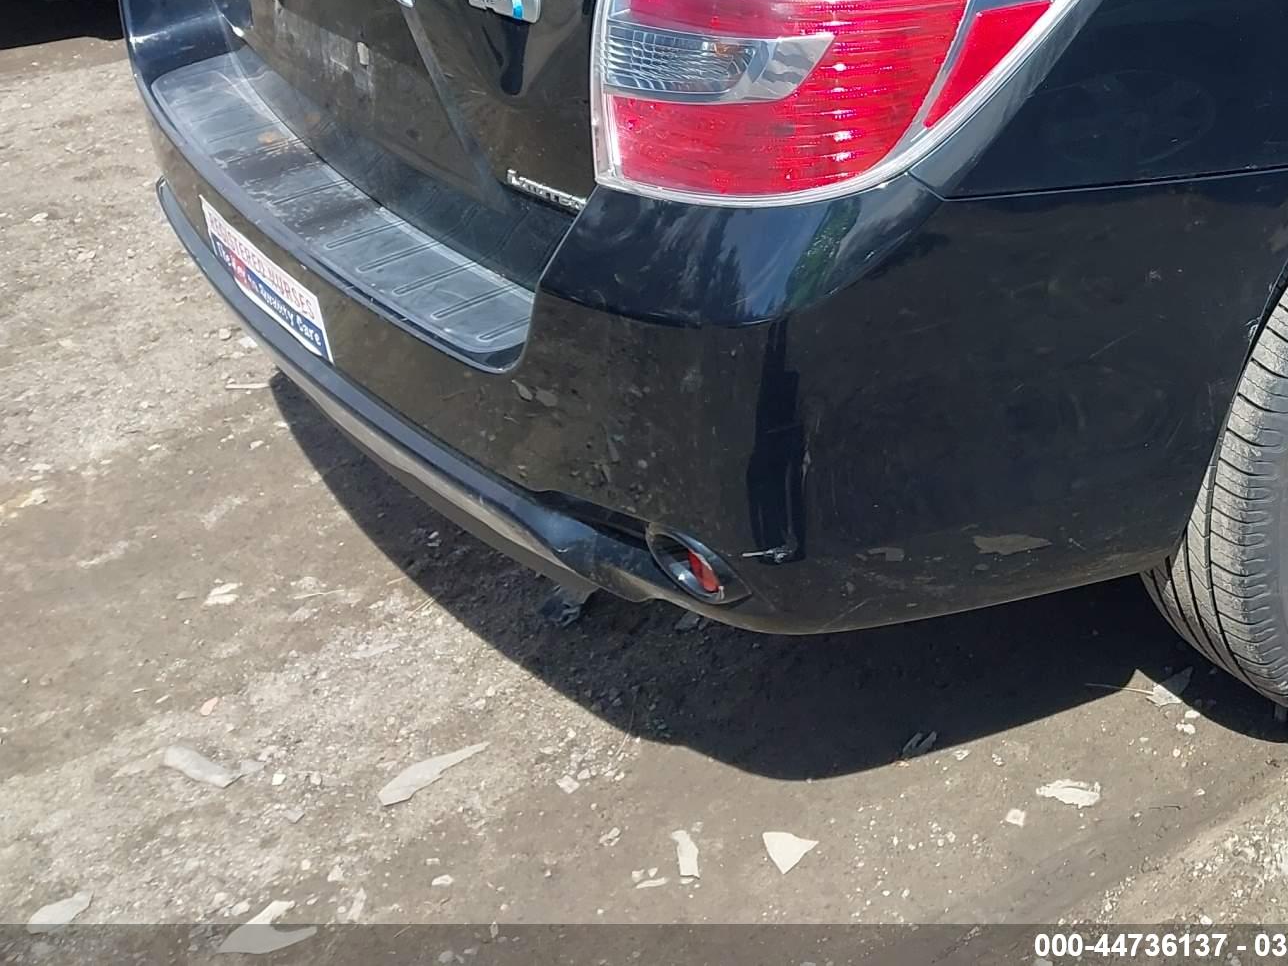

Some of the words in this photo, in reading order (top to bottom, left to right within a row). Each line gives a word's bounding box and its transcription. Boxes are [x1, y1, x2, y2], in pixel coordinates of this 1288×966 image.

[209, 212, 265, 276] REGISTERED
[266, 266, 316, 320] NURSES
[296, 315, 322, 347] Care
